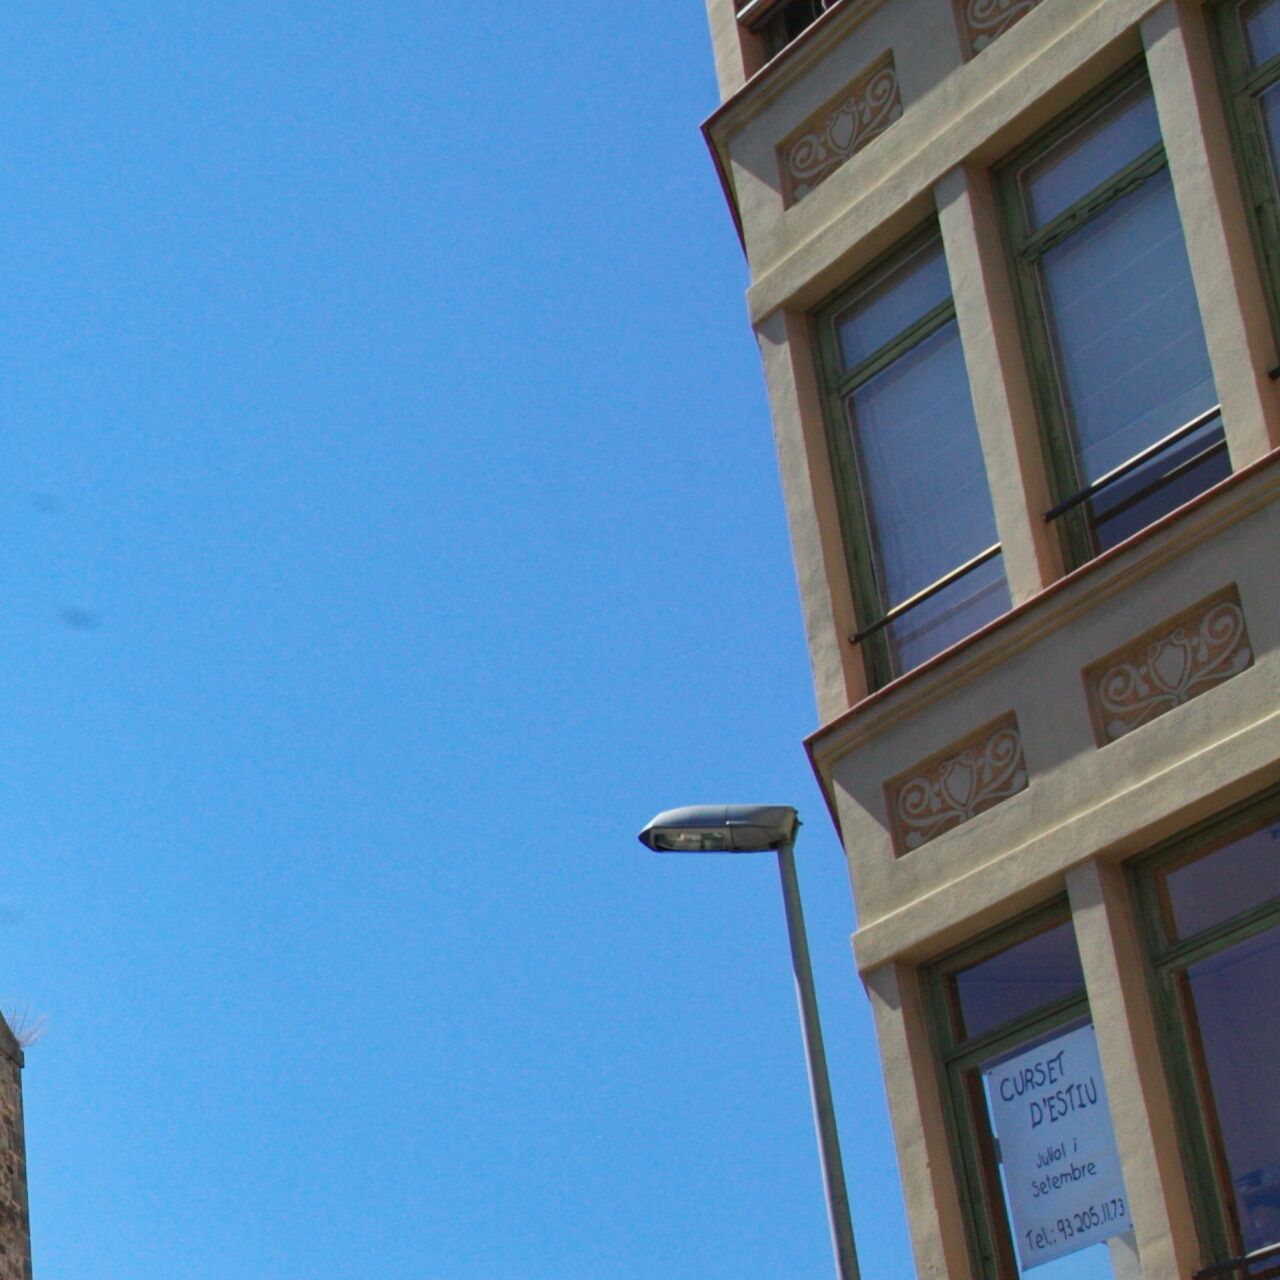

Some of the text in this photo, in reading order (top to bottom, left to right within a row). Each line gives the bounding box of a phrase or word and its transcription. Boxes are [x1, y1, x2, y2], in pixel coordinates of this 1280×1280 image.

[1000, 1050, 1064, 1102] CURSET
[1029, 1077, 1098, 1129] D'ESTIU
[1036, 1137, 1078, 1169] Juliol i
[1031, 1161, 1096, 1198] Setembre
